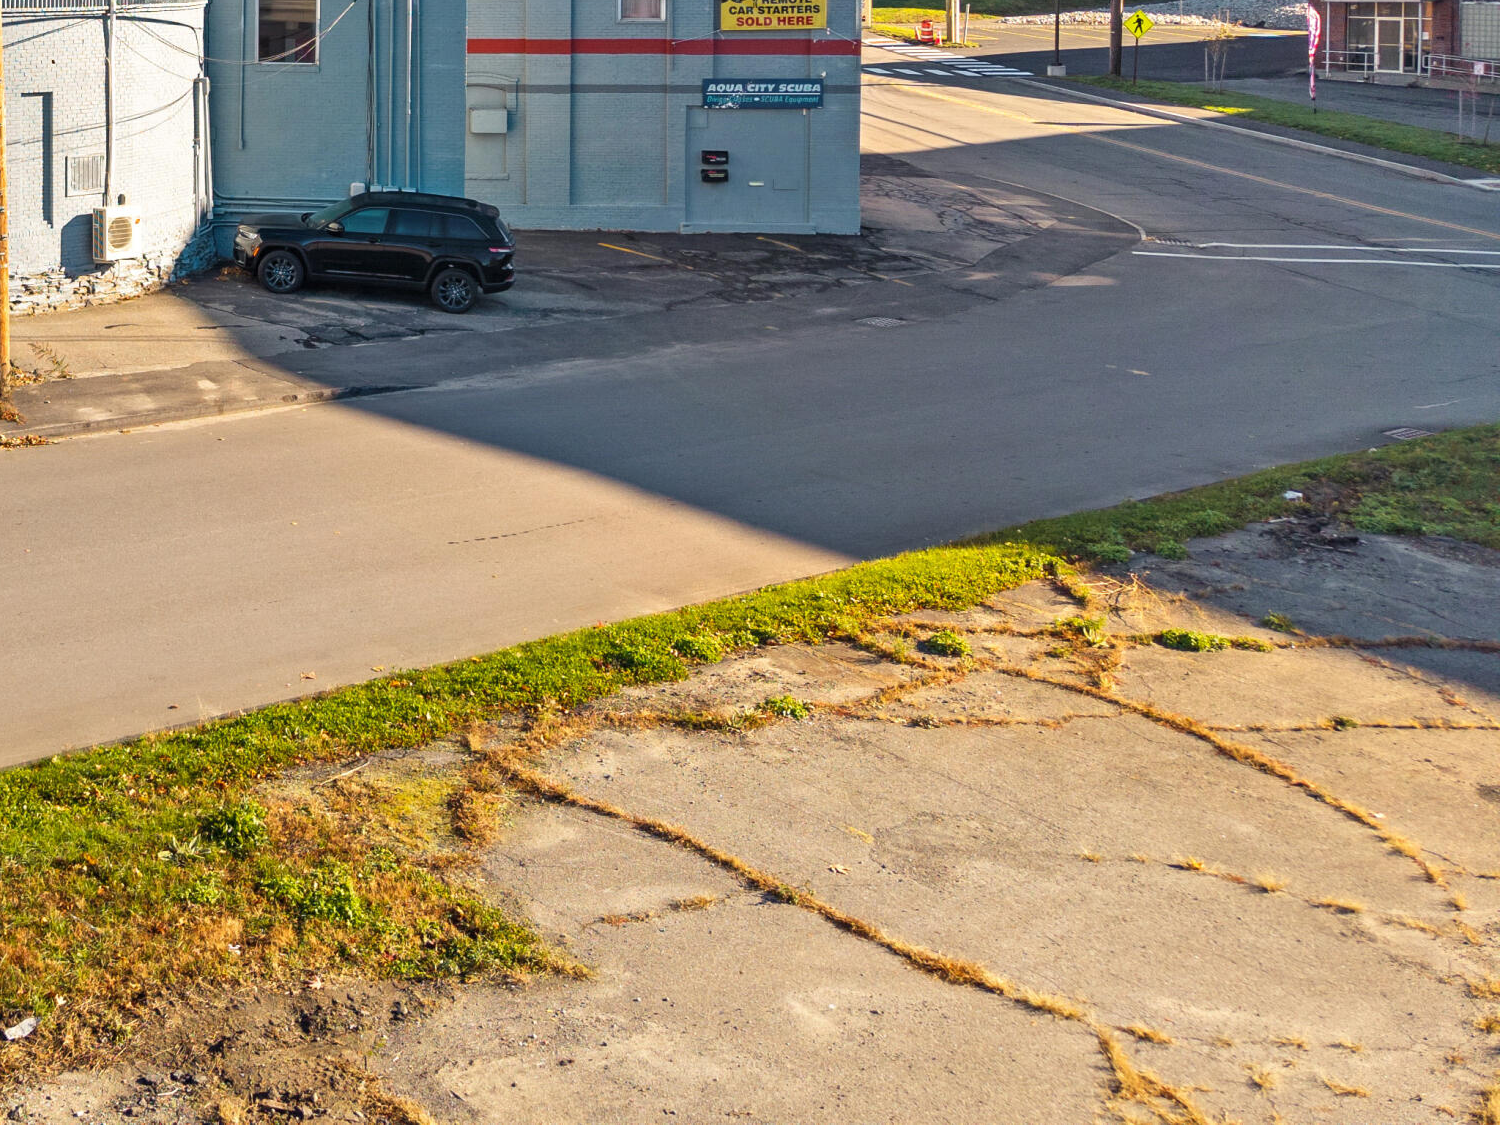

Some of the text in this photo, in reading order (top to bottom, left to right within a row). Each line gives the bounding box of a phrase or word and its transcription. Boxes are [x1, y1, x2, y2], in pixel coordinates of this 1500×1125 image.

[729, 5, 820, 15] CAR STARTERS
[736, 16, 814, 26] SOLD HERE
[707, 84, 820, 92] AQUA CITY SCUBA
